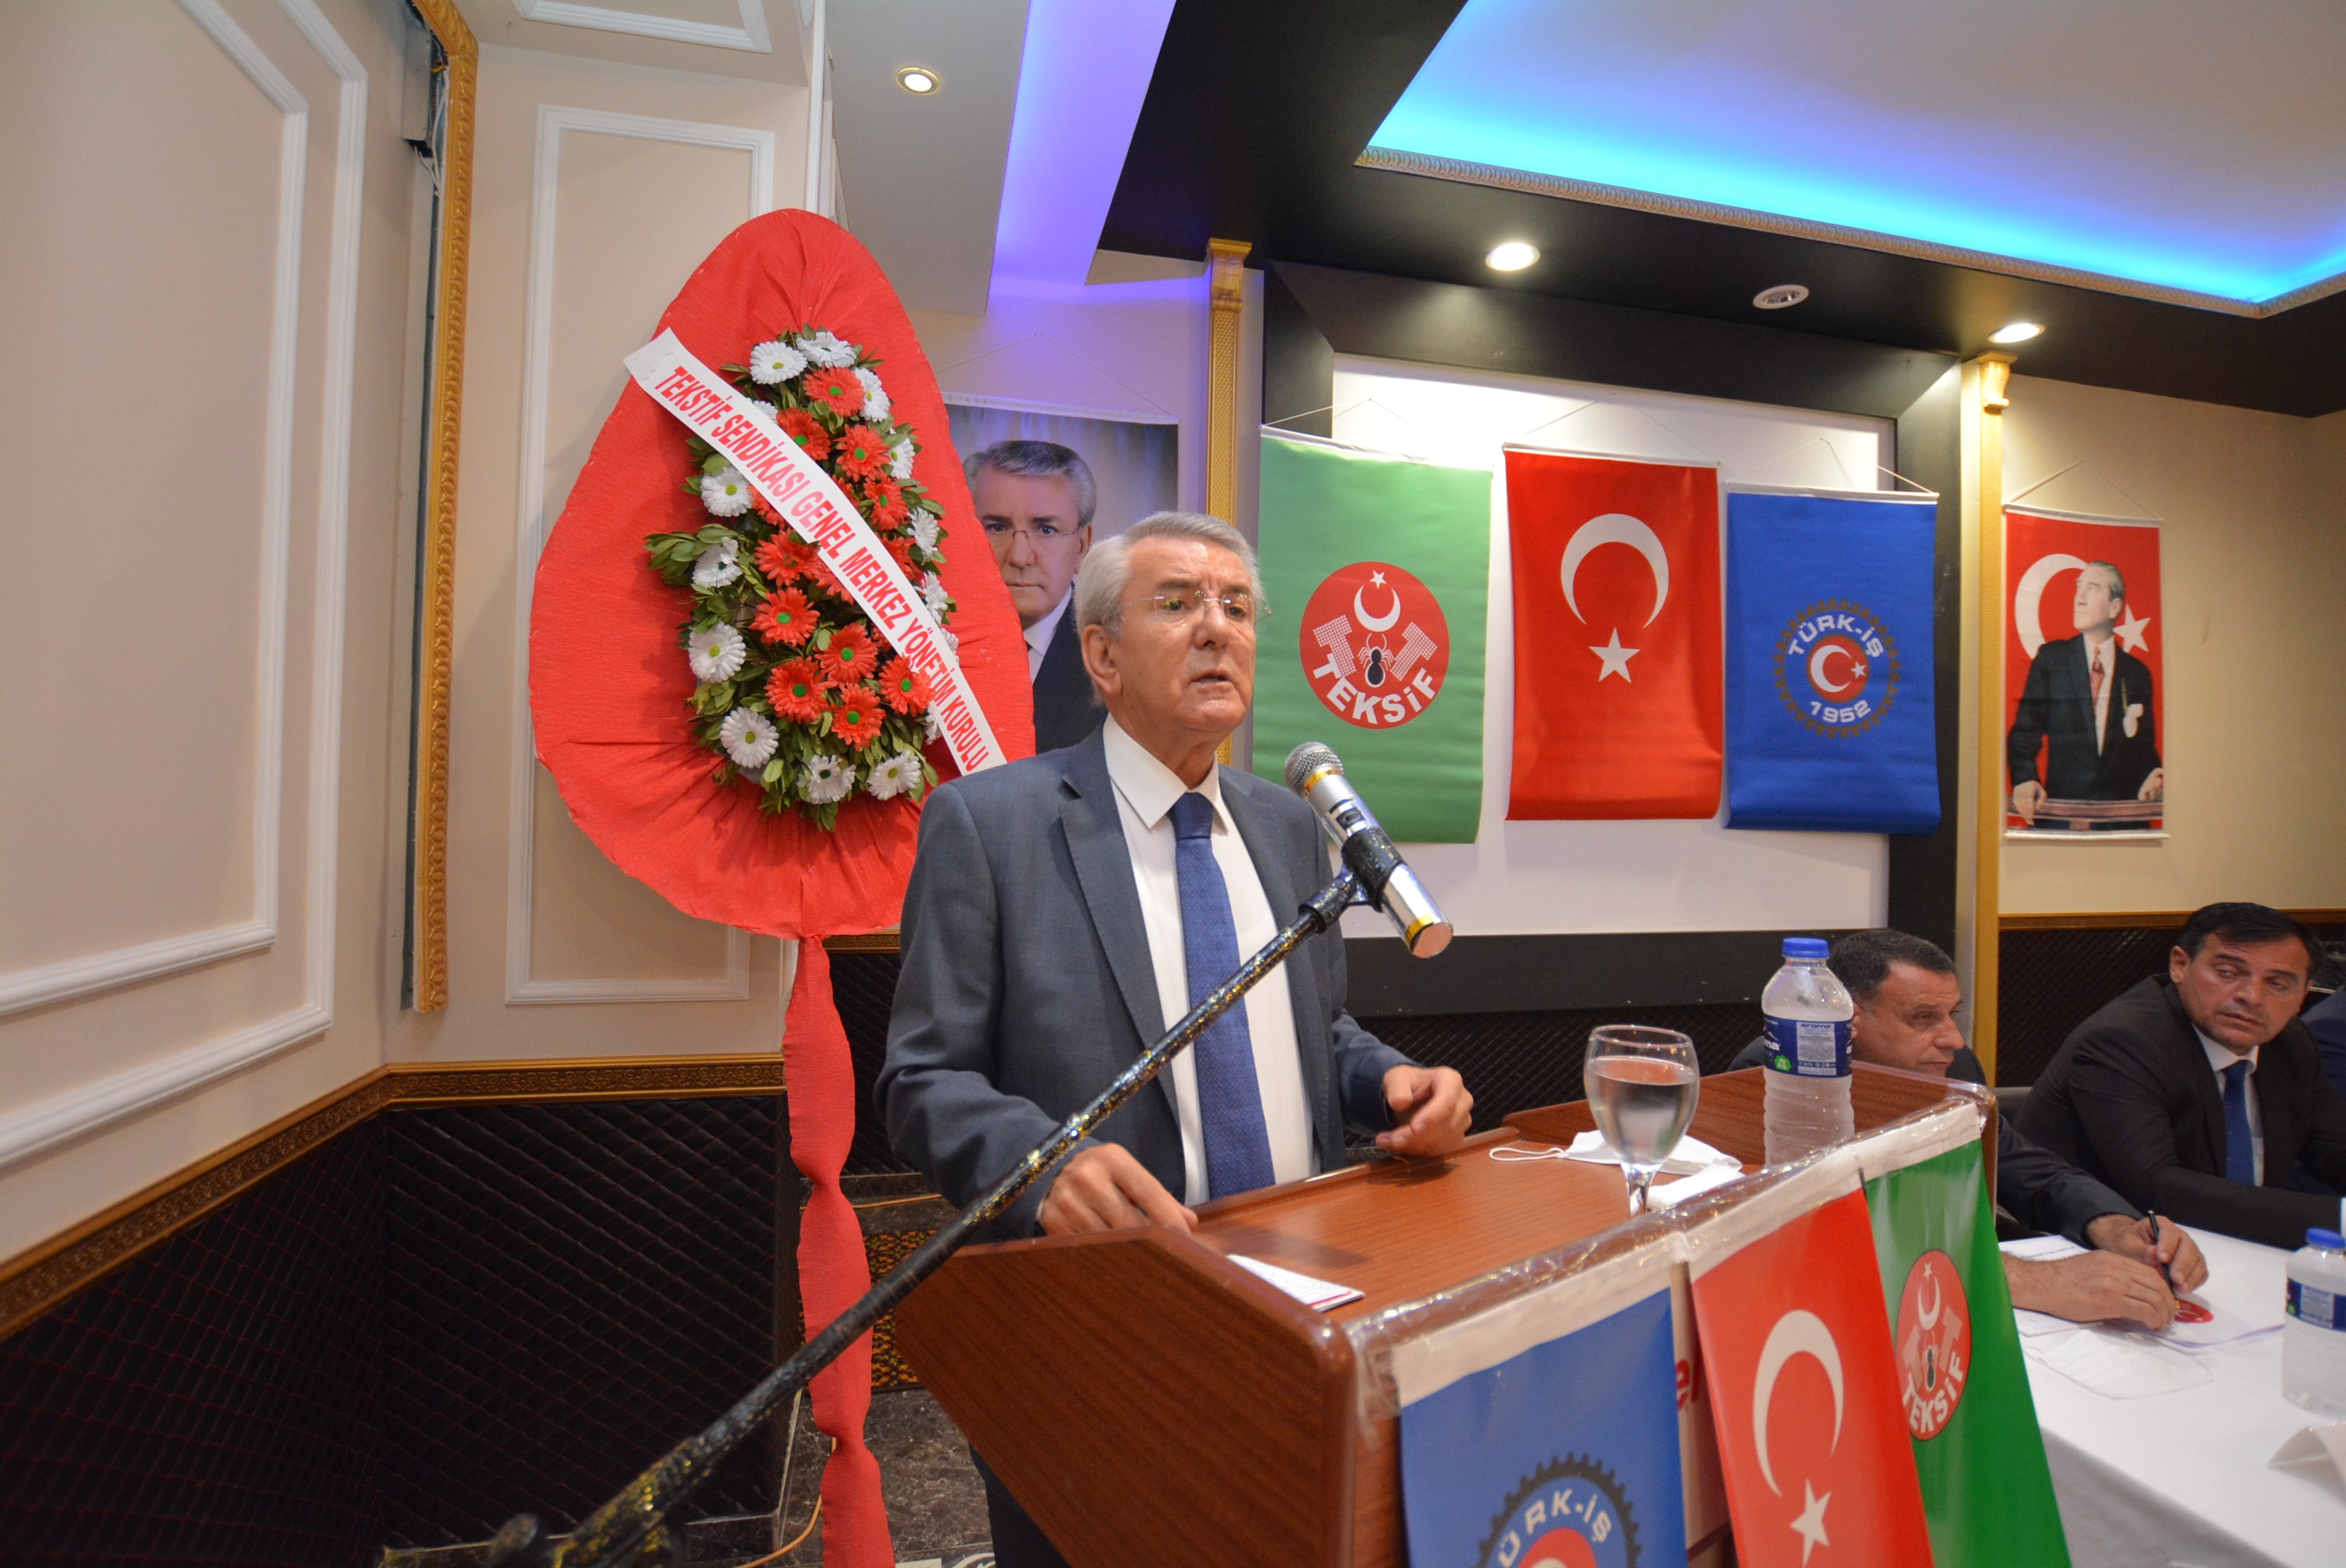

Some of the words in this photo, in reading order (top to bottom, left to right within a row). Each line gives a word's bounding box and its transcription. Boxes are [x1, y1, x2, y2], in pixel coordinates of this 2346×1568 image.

[655, 365, 733, 426] TEKSTİF
[710, 414, 811, 503] SENDİKASI
[790, 491, 856, 560] GENEL
[838, 546, 913, 630] MERKEZ
[897, 617, 957, 706] YÖNETİM
[940, 695, 989, 772] KURULU
[1789, 614, 1884, 659] TÜRK-İŞ
[1810, 699, 1872, 723] 1952
[1498, 1489, 1612, 1568] ÜRK-İŞ
